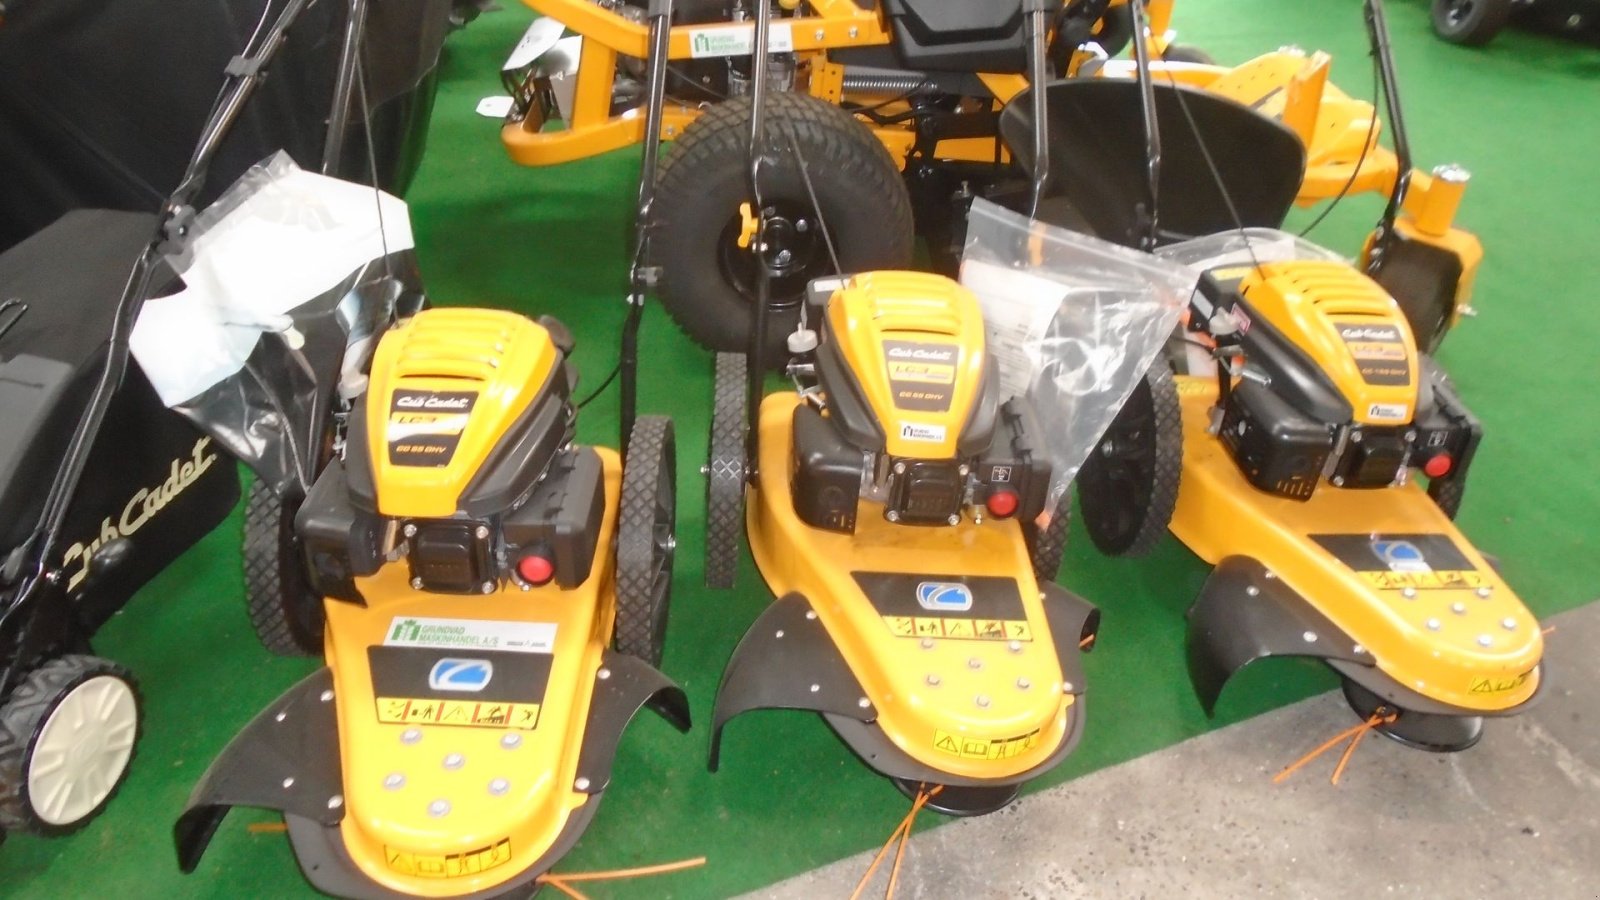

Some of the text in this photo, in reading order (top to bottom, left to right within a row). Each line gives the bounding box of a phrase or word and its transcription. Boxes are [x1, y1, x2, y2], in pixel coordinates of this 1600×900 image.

[1342, 329, 1396, 339] Cub Cadet
[888, 348, 952, 360] Cub Cadet
[396, 396, 469, 408] Cub Cadet
[118, 436, 213, 536] Cadet
[421, 625, 466, 635] GRUNDVAD
[419, 633, 479, 644] MASKINHANDEL
[482, 636, 499, 645] A/S
